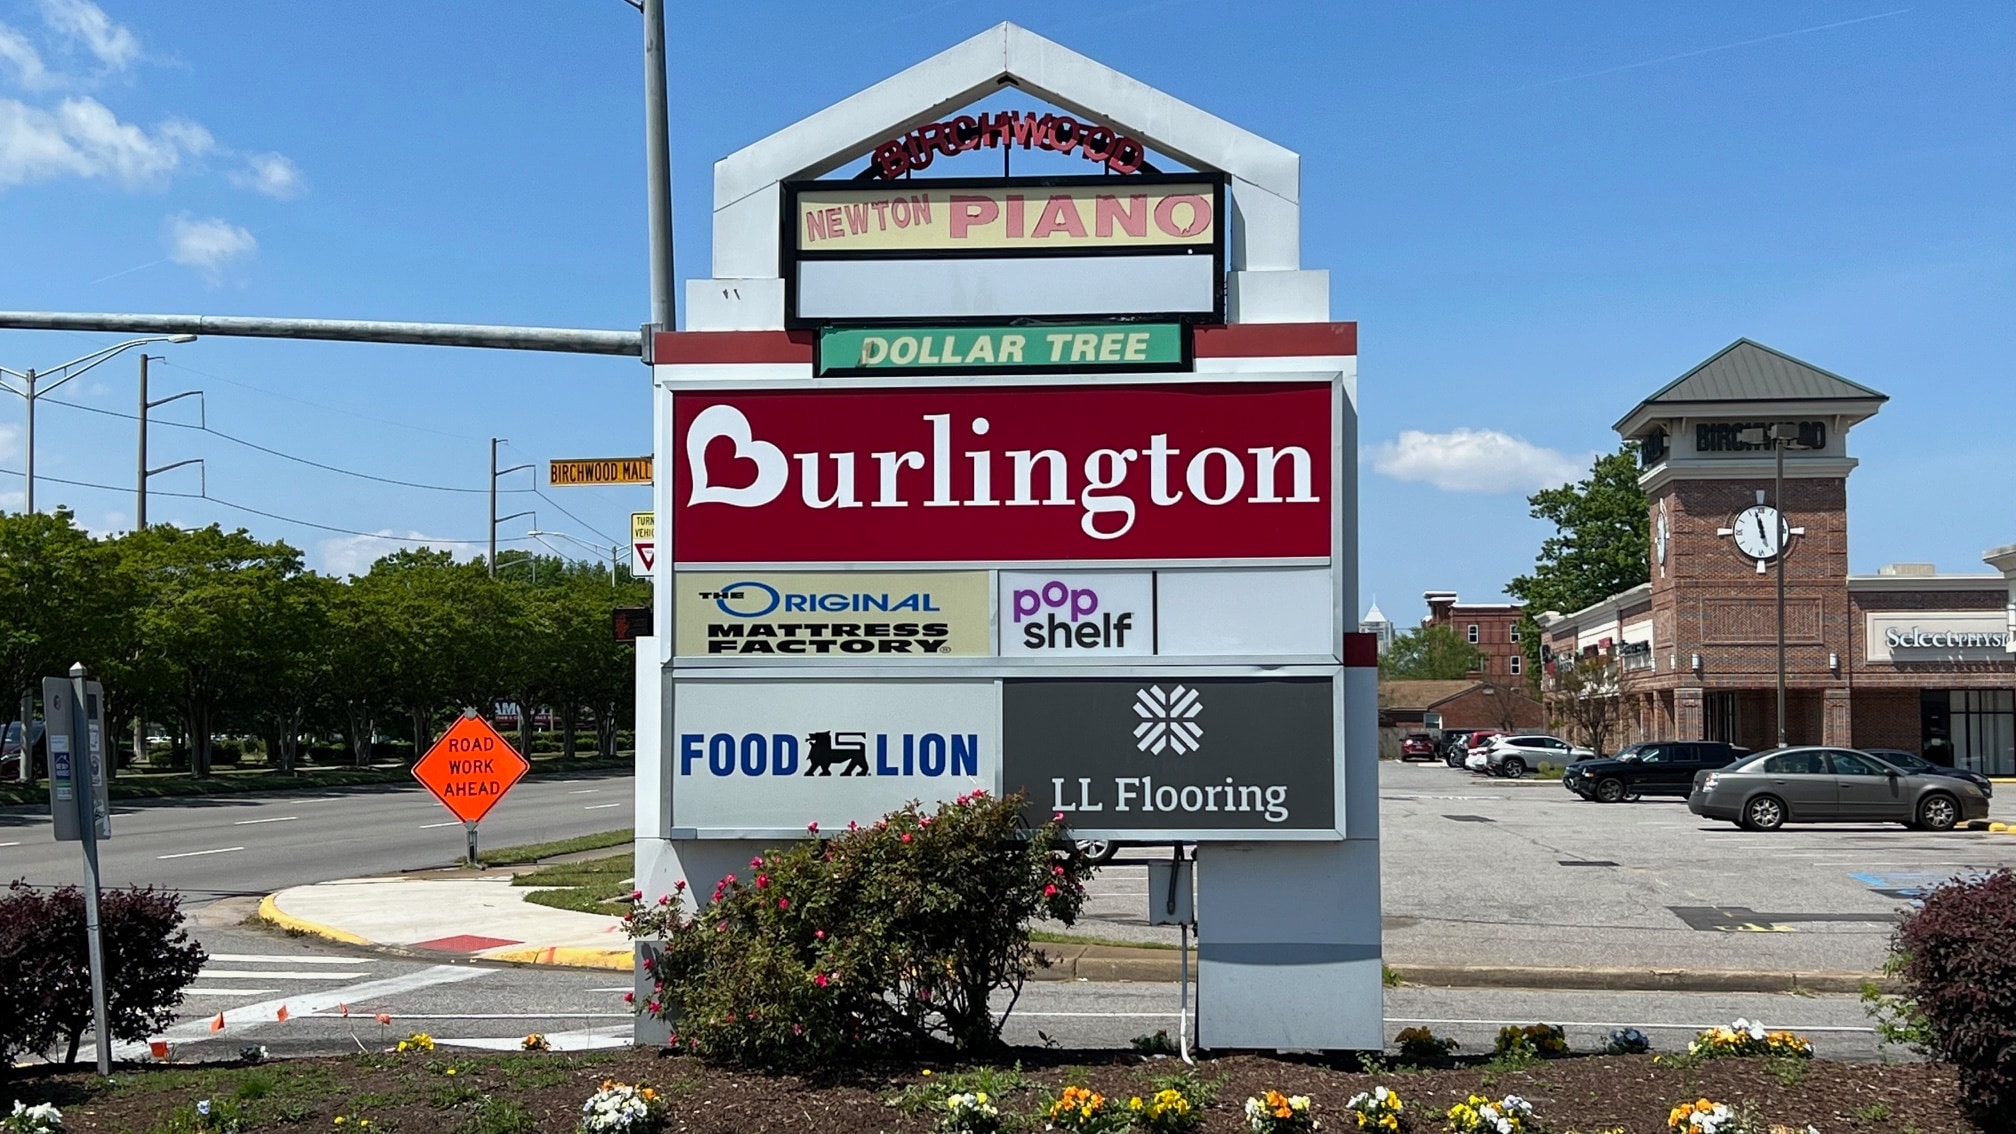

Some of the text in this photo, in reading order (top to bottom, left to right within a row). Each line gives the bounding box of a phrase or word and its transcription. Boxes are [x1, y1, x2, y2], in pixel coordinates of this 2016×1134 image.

[873, 110, 1145, 180] BIRCHWOOD
[806, 193, 1213, 242] NEWTON PIANO
[860, 332, 1150, 367] DOLLAR TREE
[551, 461, 652, 483] BIRCHWOOD MALL
[686, 404, 1320, 540] Burlington
[716, 581, 940, 618] ORIGINAL
[1013, 580, 1099, 623] pop
[708, 623, 949, 638] MATTRESS
[1023, 611, 1133, 649] shelf
[449, 737, 494, 752] ROAD
[680, 732, 978, 777] FOOD LION
[449, 759, 494, 775] WORK
[444, 781, 500, 797] AHEAD
[1052, 776, 1287, 822] LL Flooring
